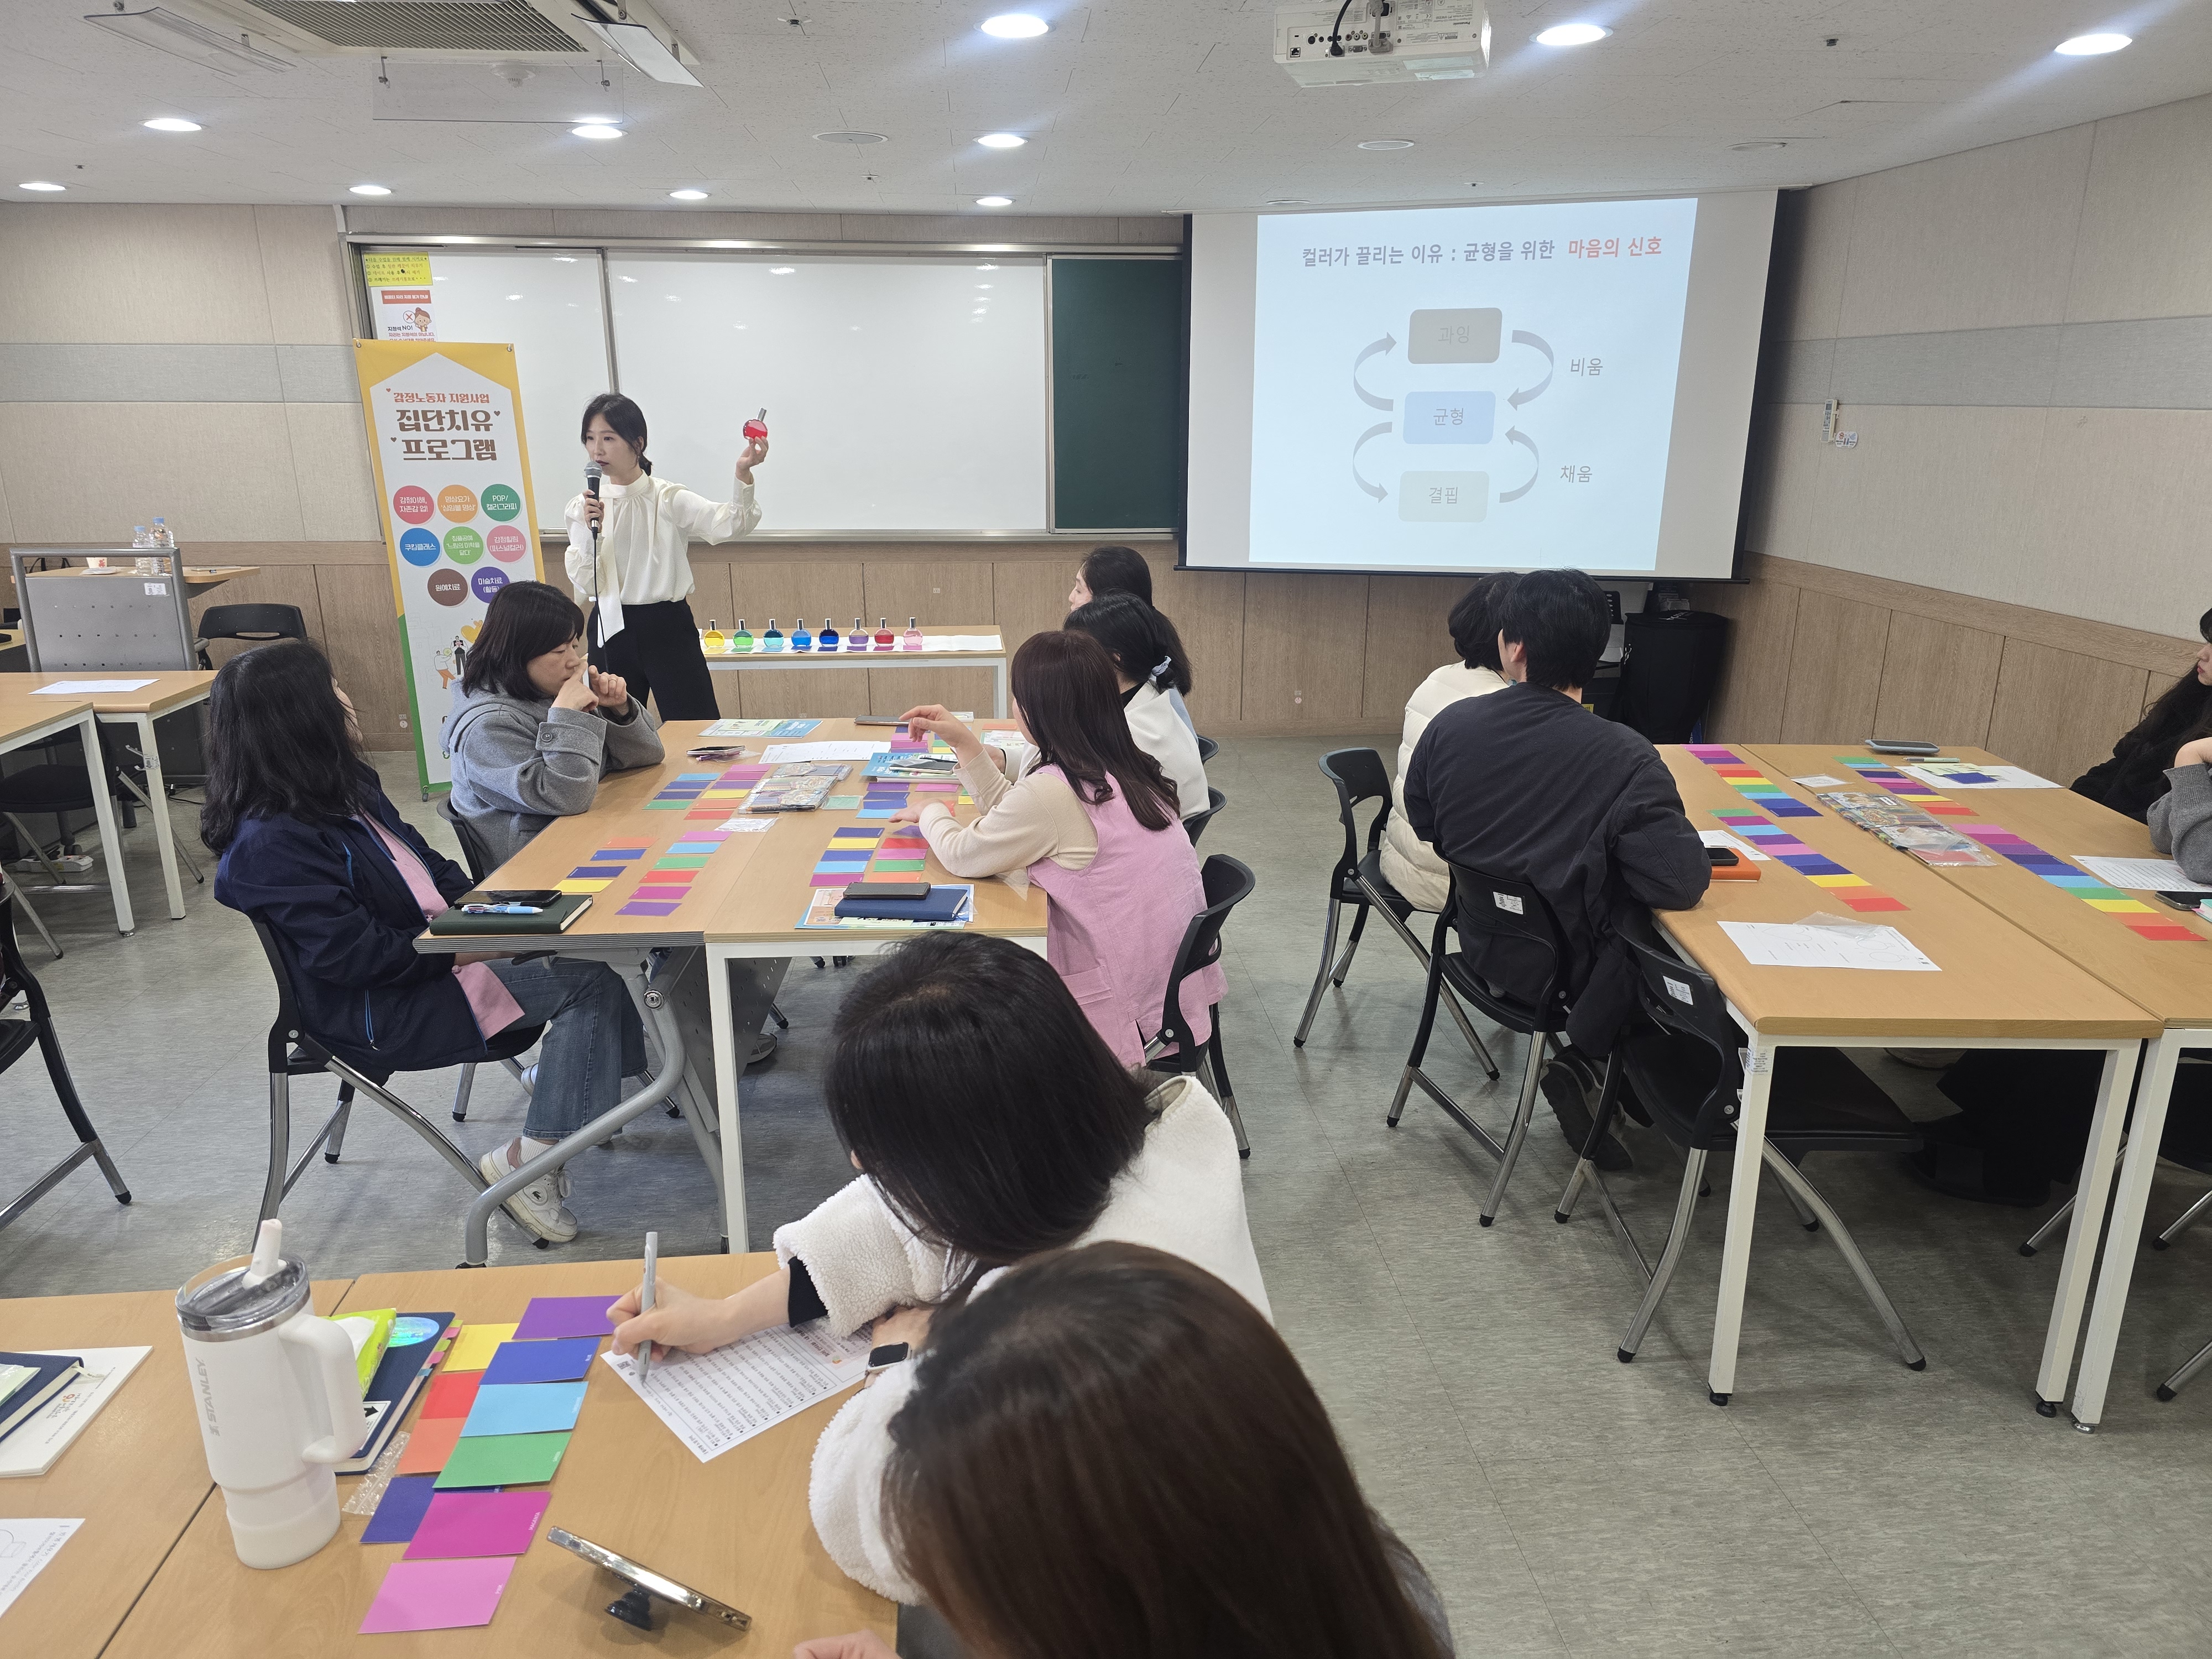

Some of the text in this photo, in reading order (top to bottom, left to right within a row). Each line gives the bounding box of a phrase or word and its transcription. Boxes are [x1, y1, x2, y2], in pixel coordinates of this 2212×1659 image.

[1302, 236, 1662, 267] 컬러가 끌리는 이유 : 균형을 위한 마음의 신호
[1438, 325, 1470, 345] 과잉
[1570, 357, 1603, 377] 비움
[393, 393, 490, 403] 감정노동자 지원사업
[396, 409, 493, 432] 집단치유
[1433, 408, 1464, 426] 균형
[401, 439, 497, 461] 프로그램
[1559, 465, 1593, 483] 채움
[1428, 486, 1458, 504] 결핍
[195, 1357, 217, 1423] STANLEY
